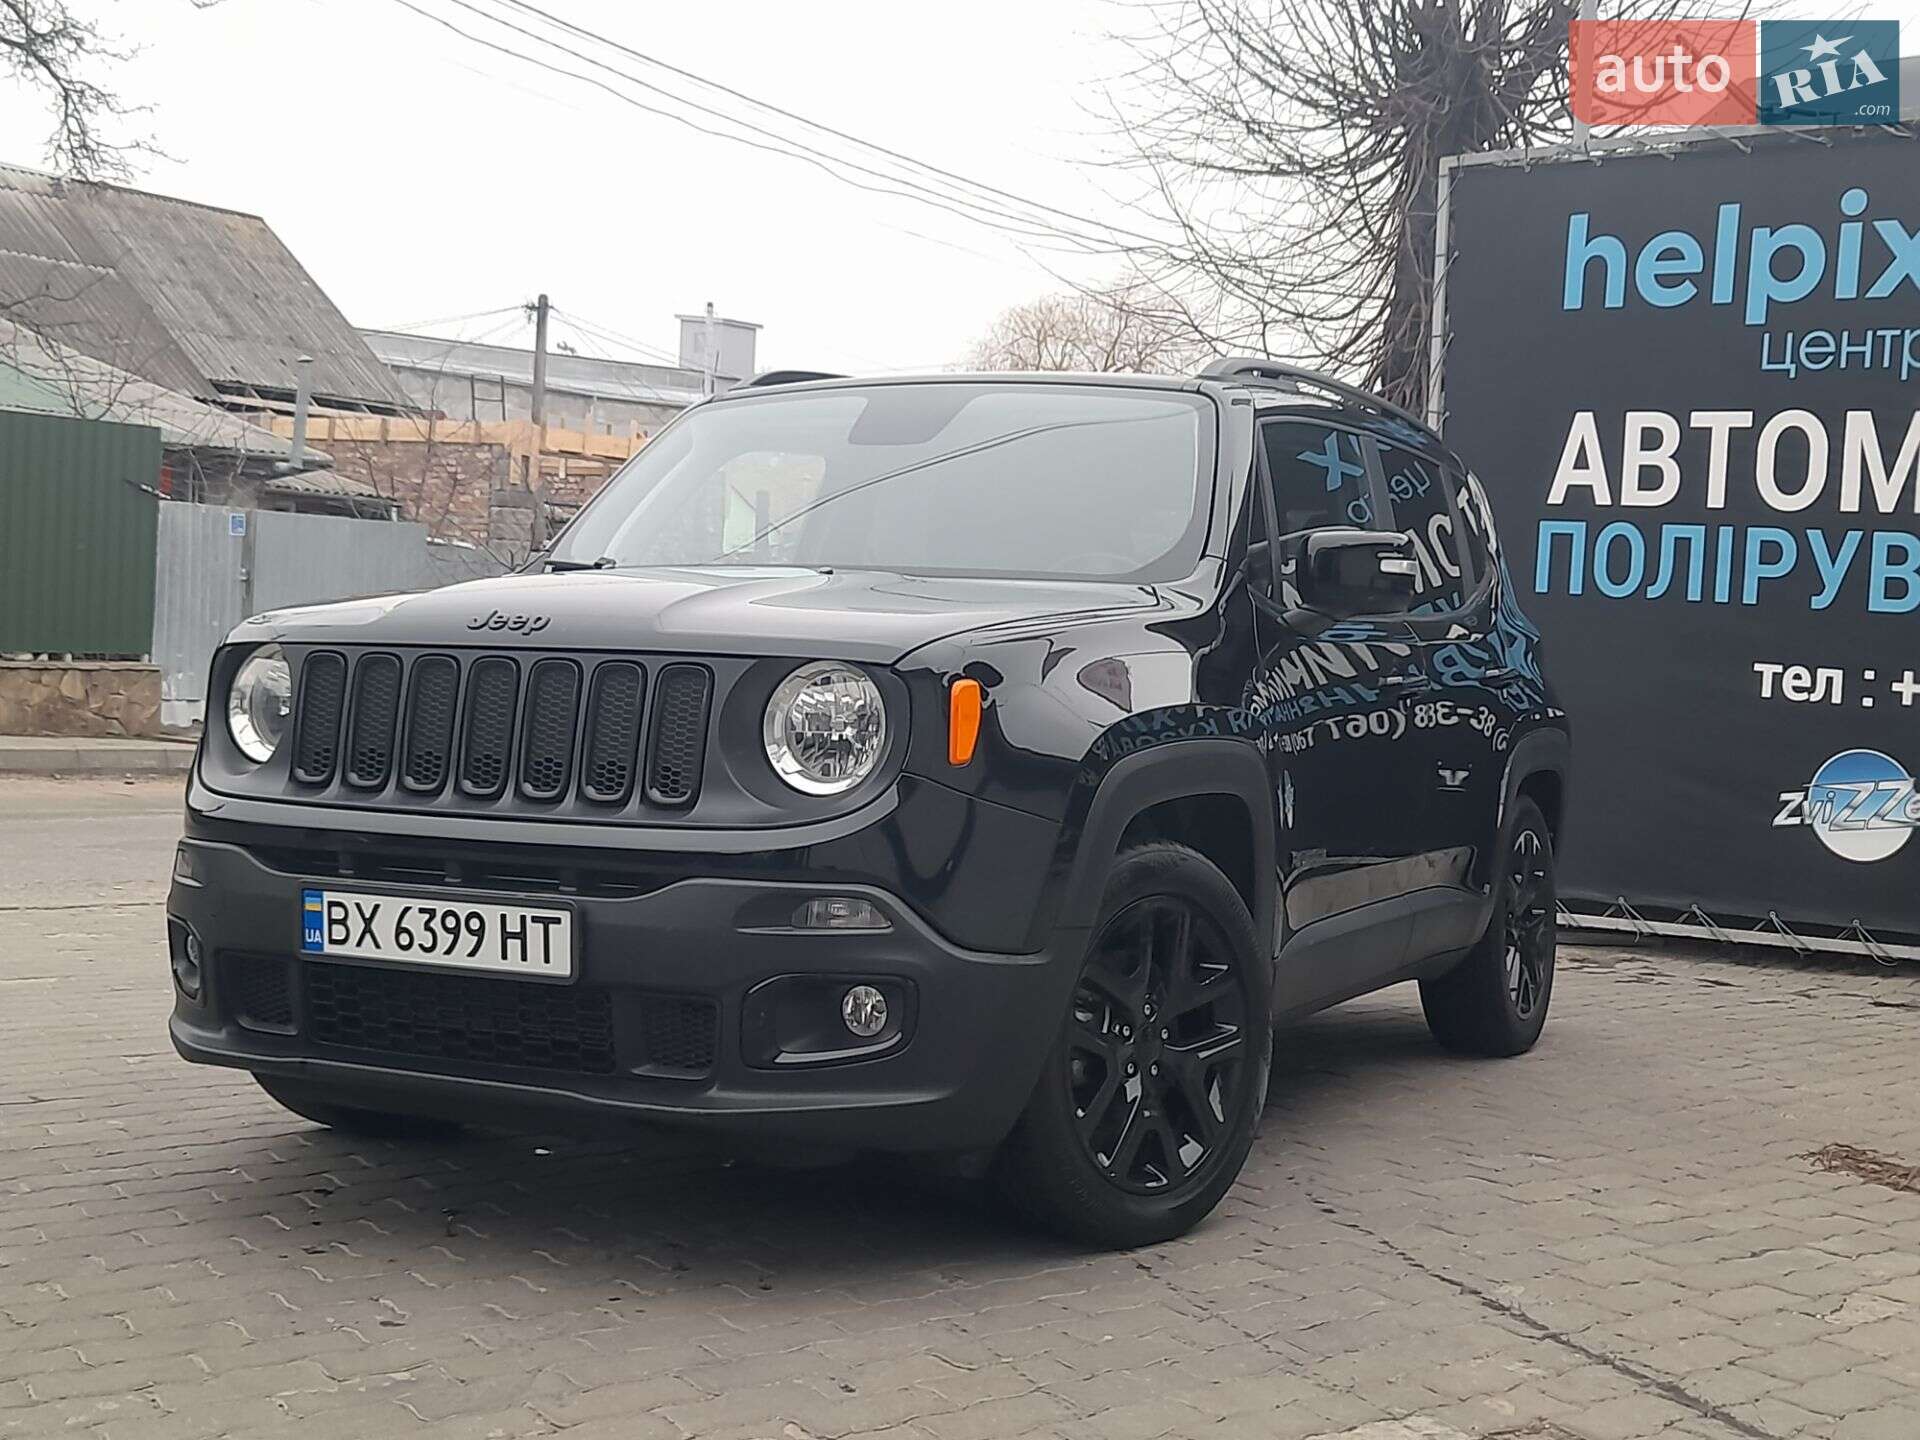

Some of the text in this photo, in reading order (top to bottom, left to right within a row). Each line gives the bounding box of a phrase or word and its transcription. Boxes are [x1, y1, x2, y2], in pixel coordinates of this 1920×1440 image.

[1546, 410, 1920, 514] АВТОМ
[1535, 520, 1920, 613] ПОЛІРУВ
[466, 609, 552, 637] Jeep
[305, 928, 322, 944] UA
[327, 901, 562, 964] BX 6399 HT
